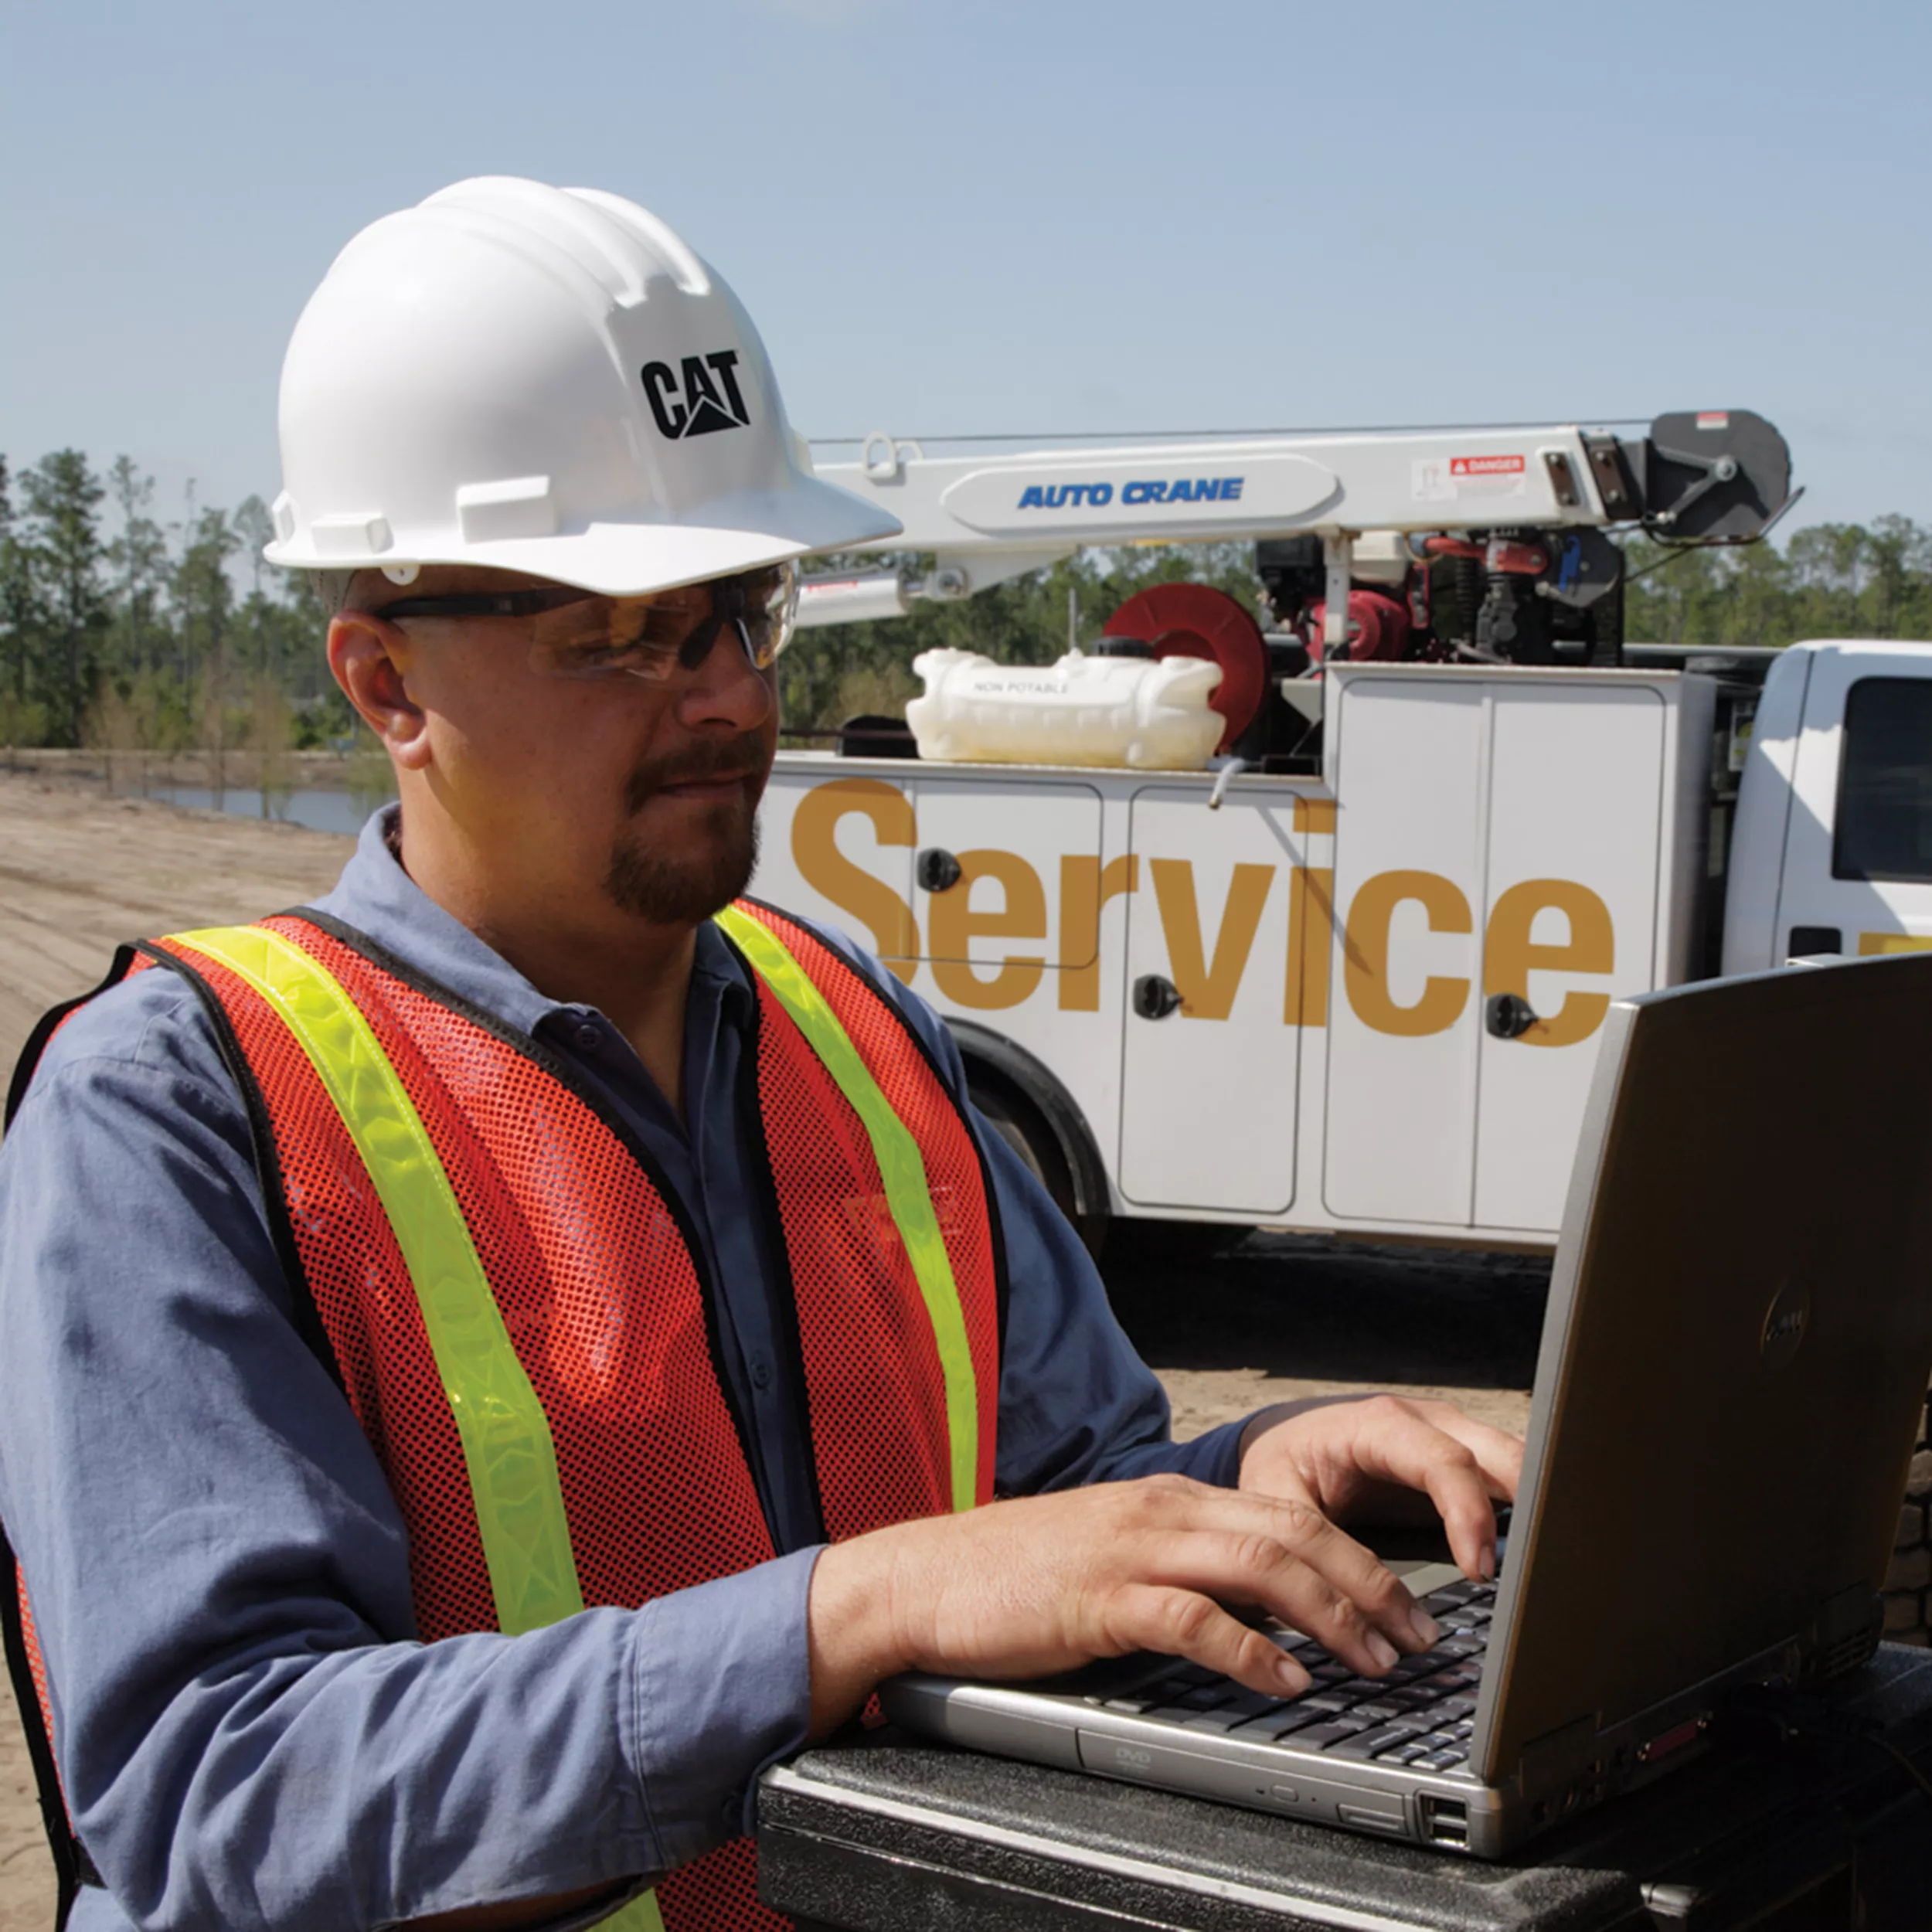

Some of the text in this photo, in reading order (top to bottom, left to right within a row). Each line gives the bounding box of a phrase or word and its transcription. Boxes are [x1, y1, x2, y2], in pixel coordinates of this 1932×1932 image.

[641, 349, 751, 440] CAT
[1468, 457, 1522, 474] DANGER
[1018, 477, 1244, 509] AUTO CRANE
[973, 681, 1068, 695] NON POTABLE
[791, 777, 1614, 1048] Service
[1115, 1747, 1151, 1764] DVD
